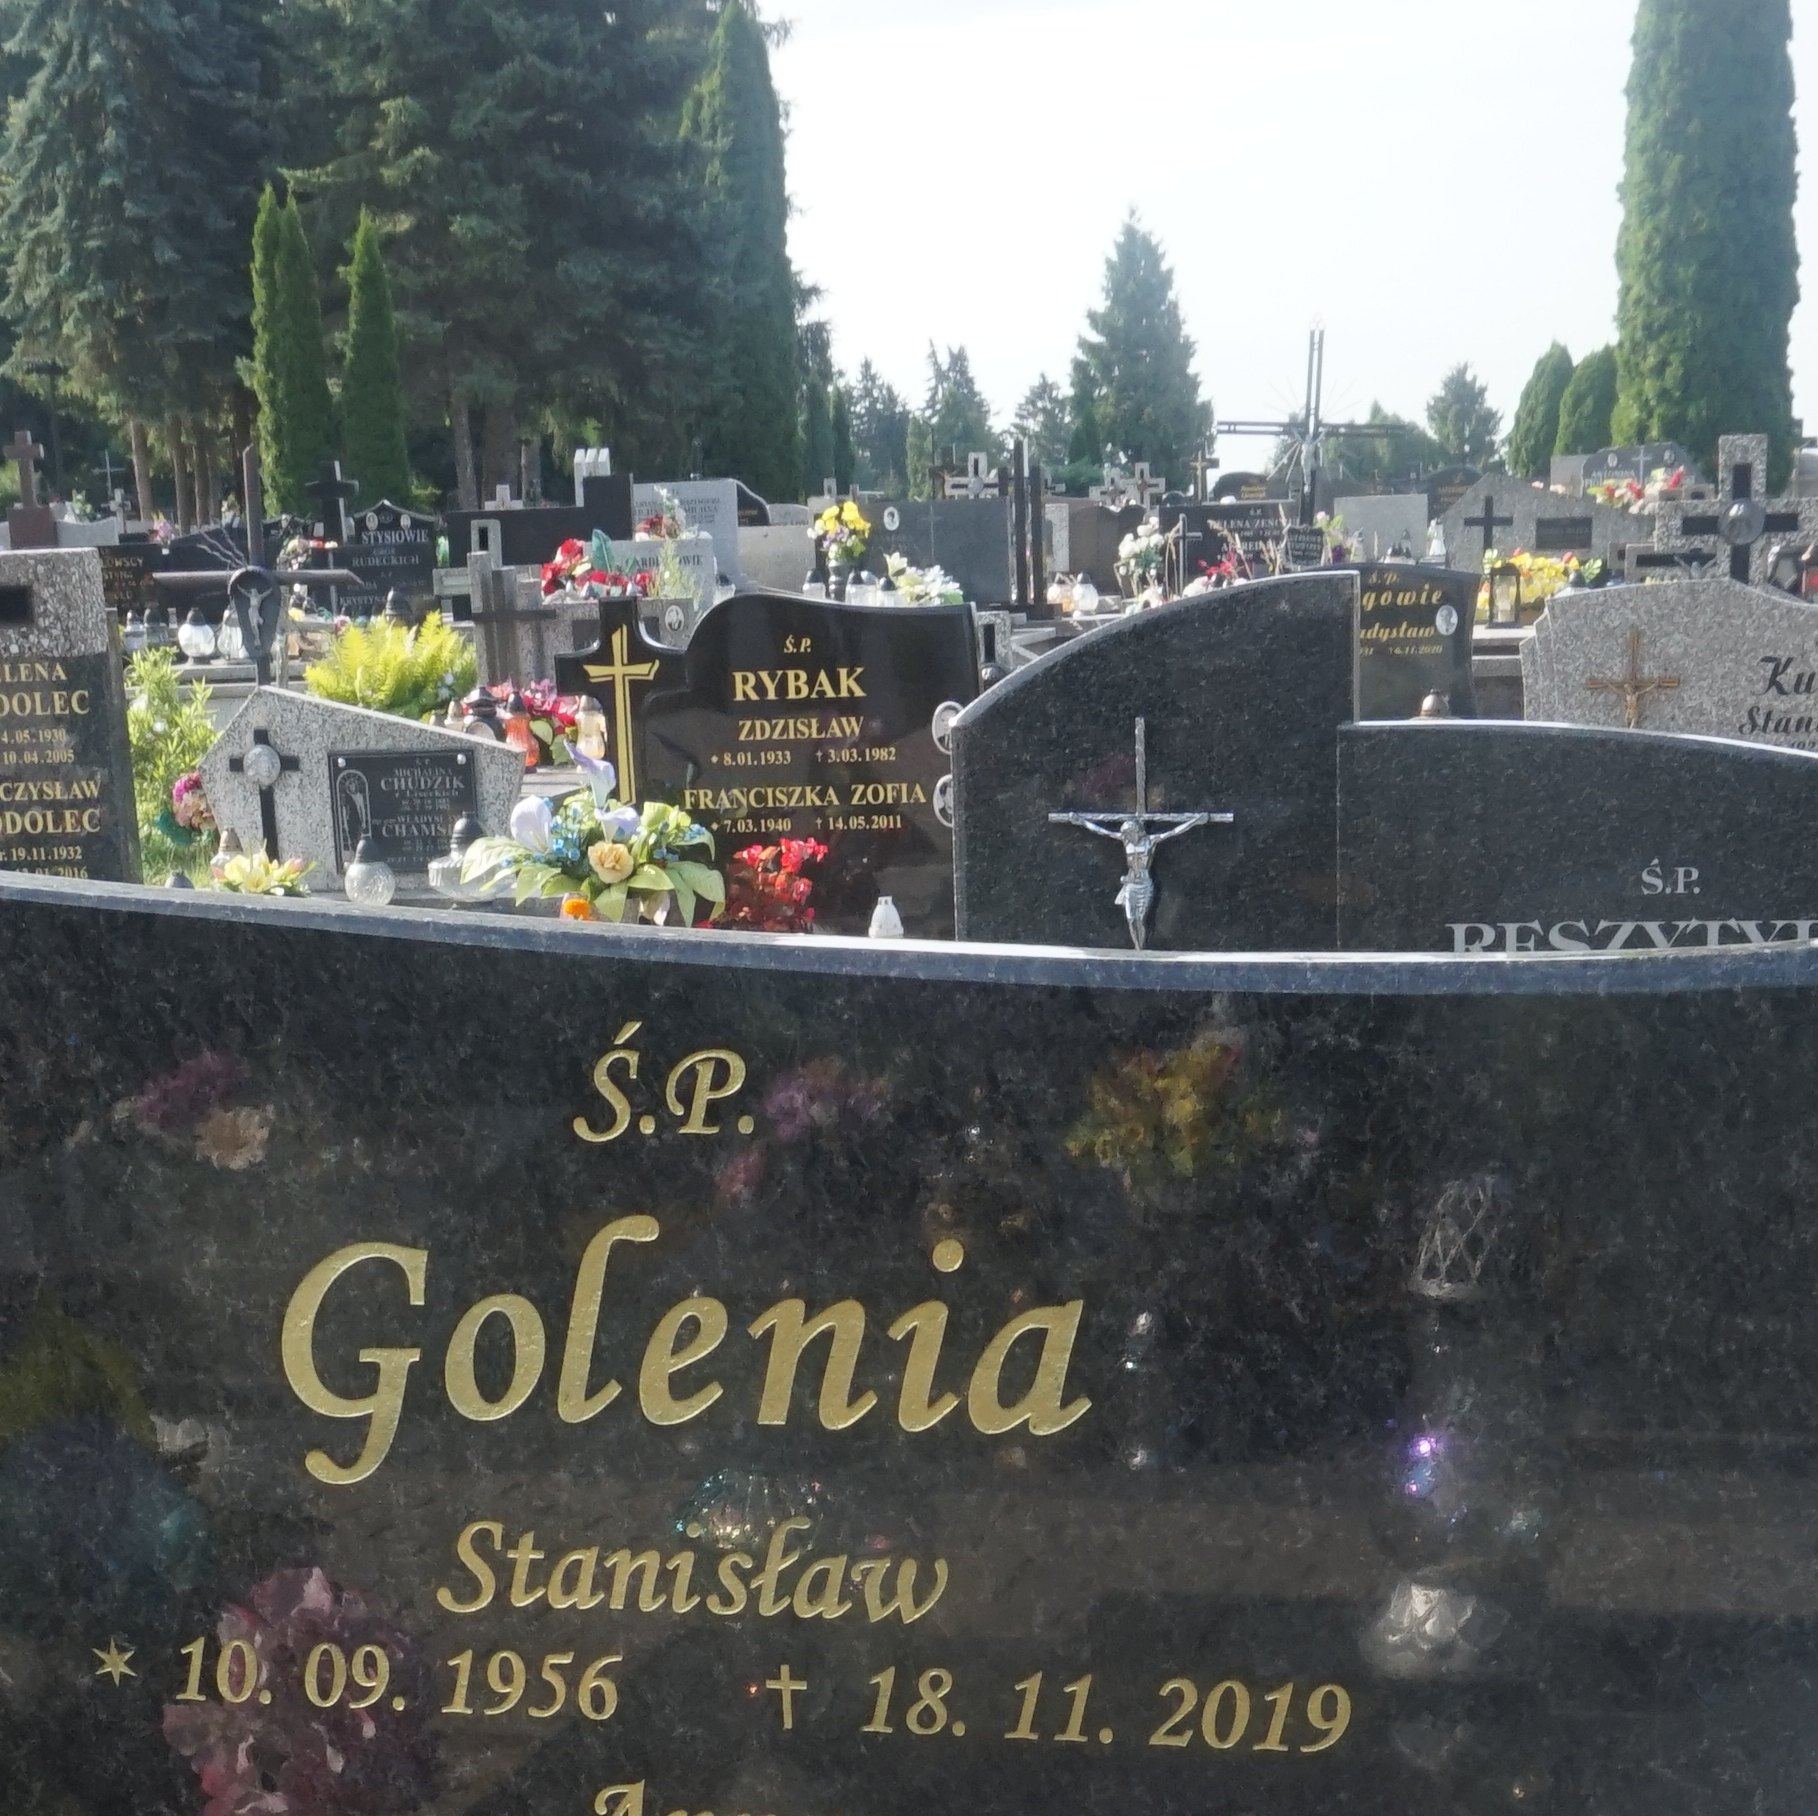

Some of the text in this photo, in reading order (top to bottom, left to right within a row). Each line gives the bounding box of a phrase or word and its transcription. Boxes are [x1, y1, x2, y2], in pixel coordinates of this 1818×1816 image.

[733, 665, 867, 702] RYBAK
[737, 713, 865, 743] ZDZISŁAW
[723, 747, 897, 766] 8.01.1933 3.03.1982
[381, 776, 466, 791] CHUDZIK
[683, 782, 928, 811] FRANCISZKA ZOFIA
[723, 814, 903, 834] 7.03.1940 14.05.2011
[1641, 857, 1702, 897] Ś.P.
[574, 1022, 756, 1143] Ś.P.
[280, 1214, 1093, 1485] Golenia
[437, 1518, 948, 1625] Stanisław
